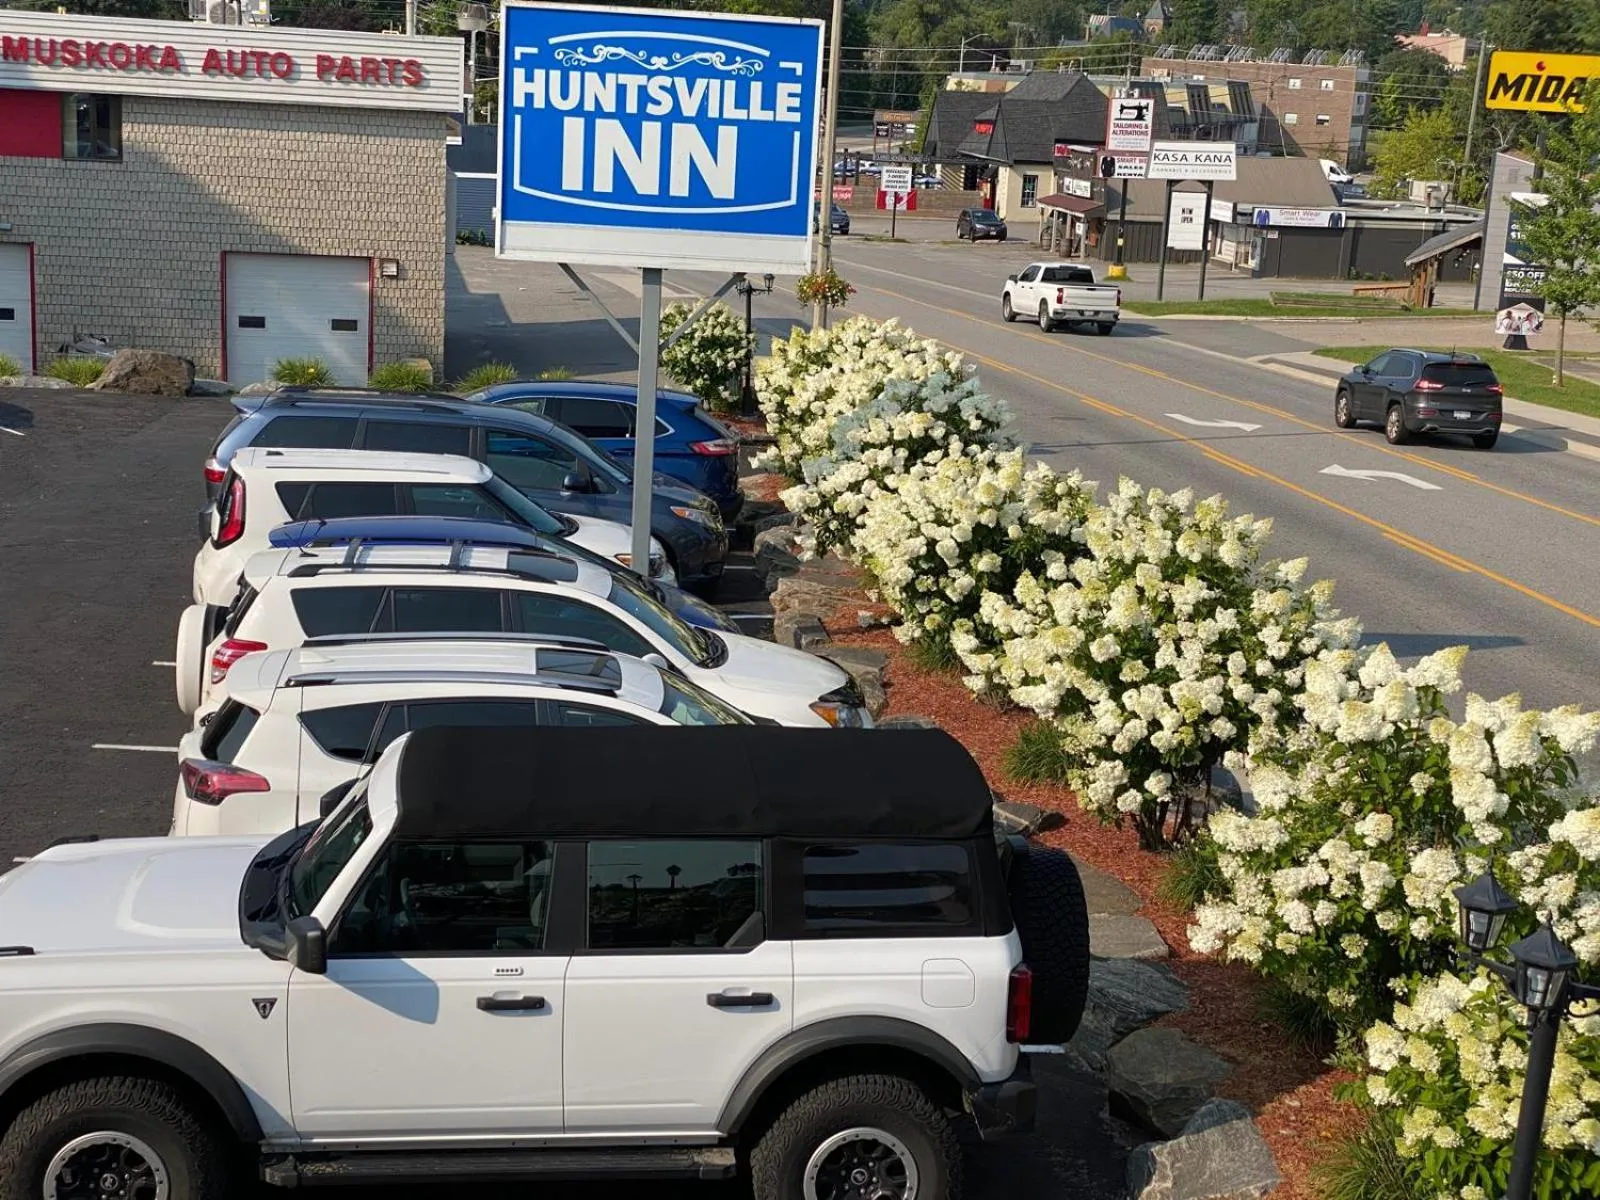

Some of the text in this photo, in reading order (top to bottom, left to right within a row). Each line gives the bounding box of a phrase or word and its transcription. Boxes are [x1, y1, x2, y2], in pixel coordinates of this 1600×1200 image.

[2, 35, 425, 86] MUSKOKA AUTO PARTS
[1489, 61, 1589, 104] MIDA
[512, 67, 802, 122] HUNTSVILLE
[561, 116, 738, 200] INN
[1153, 153, 1232, 163] KASA KANA
